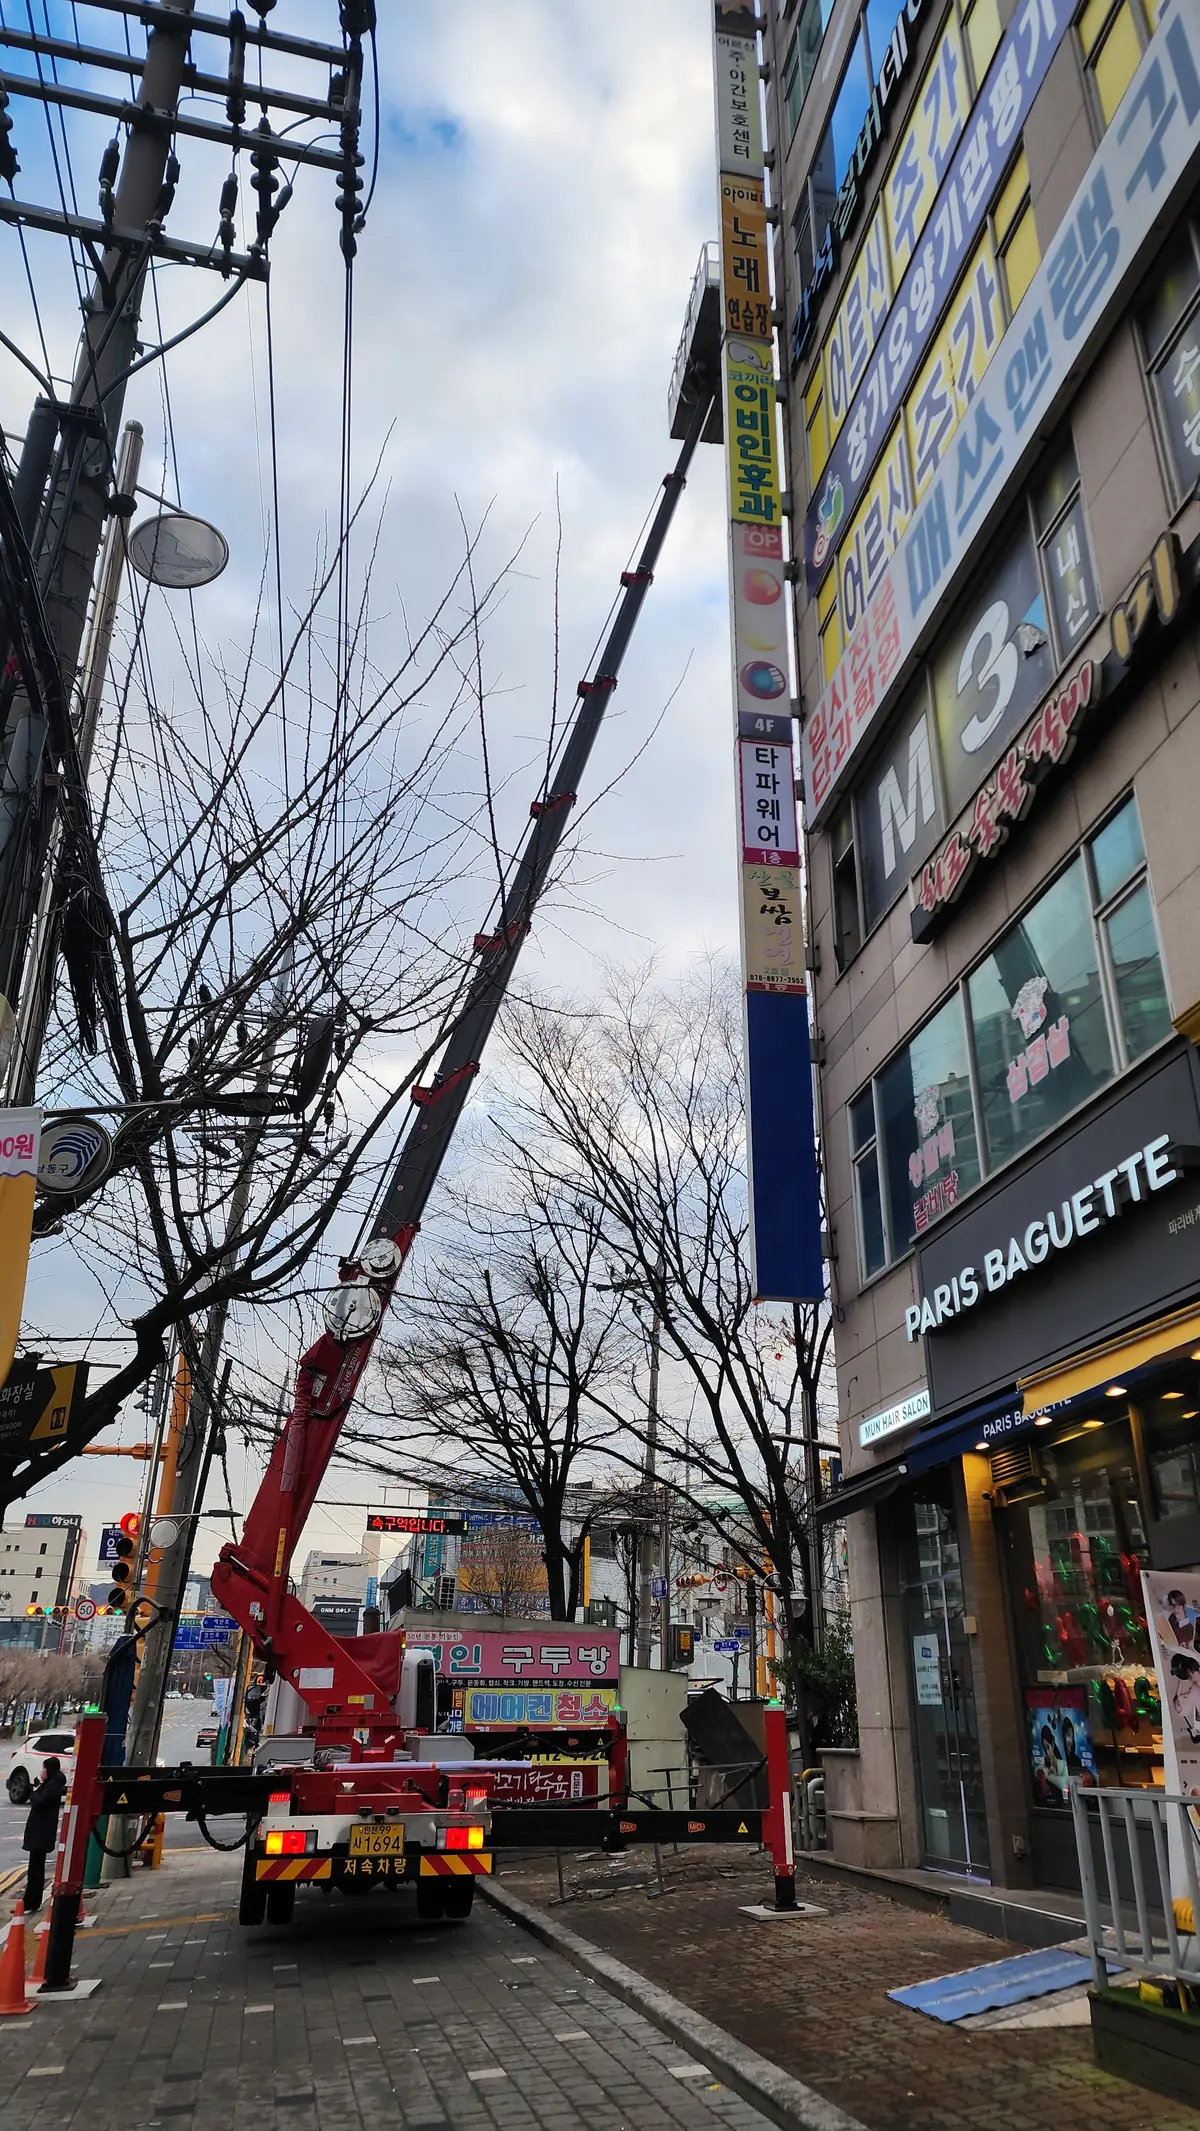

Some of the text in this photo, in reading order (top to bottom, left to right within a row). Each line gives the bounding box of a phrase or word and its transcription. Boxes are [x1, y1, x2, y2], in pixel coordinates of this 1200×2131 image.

[723, 187, 763, 204] 아이비
[731, 217, 760, 293] 노래
[728, 298, 768, 336] 연습장
[729, 370, 775, 388] 코끼리
[735, 384, 777, 521] 이비인후과
[755, 718, 775, 733] 4F
[755, 747, 780, 848] 타파웨어
[761, 851, 781, 865] 1층
[760, 887, 792, 926] 보쌈
[0, 1134, 34, 1159] 0원
[914, 1170, 958, 1232] 갈비탕
[905, 1134, 1177, 1342] PARIS BAGUETTE
[0, 1381, 35, 1403] 화장실
[864, 1397, 929, 1439] MUN HAIR SALON
[983, 1414, 1012, 1438] PARIS
[80, 1605, 92, 1615] 50
[502, 1646, 611, 1675] 구두방
[344, 1858, 407, 1875] 저속차량
